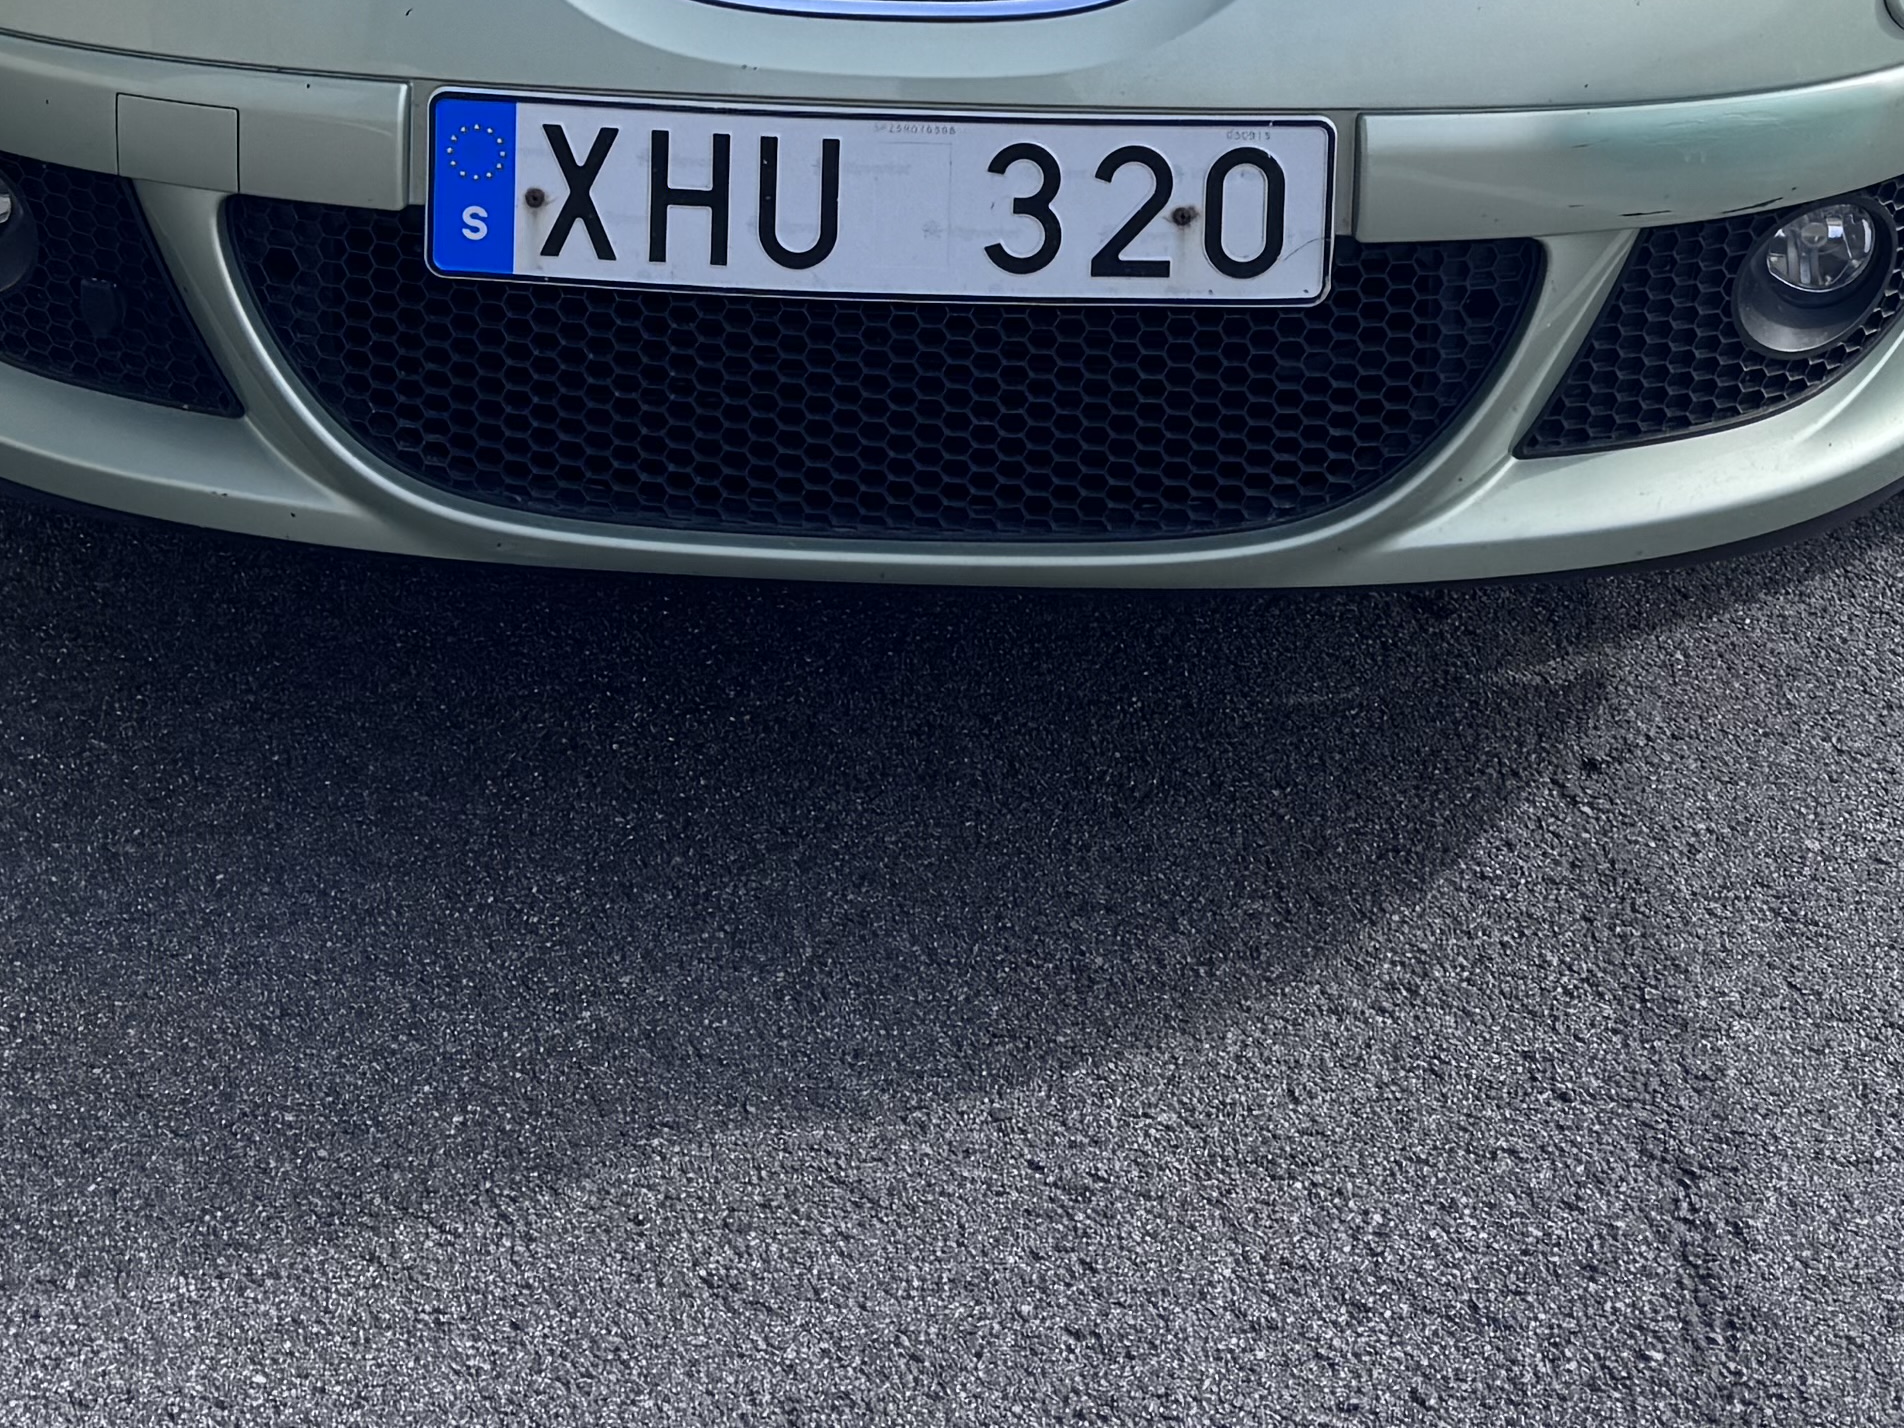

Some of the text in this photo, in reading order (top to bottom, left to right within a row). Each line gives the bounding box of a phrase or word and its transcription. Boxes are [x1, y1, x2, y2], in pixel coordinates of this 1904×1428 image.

[461, 205, 489, 241] S
[539, 123, 1286, 280] XHU 320
